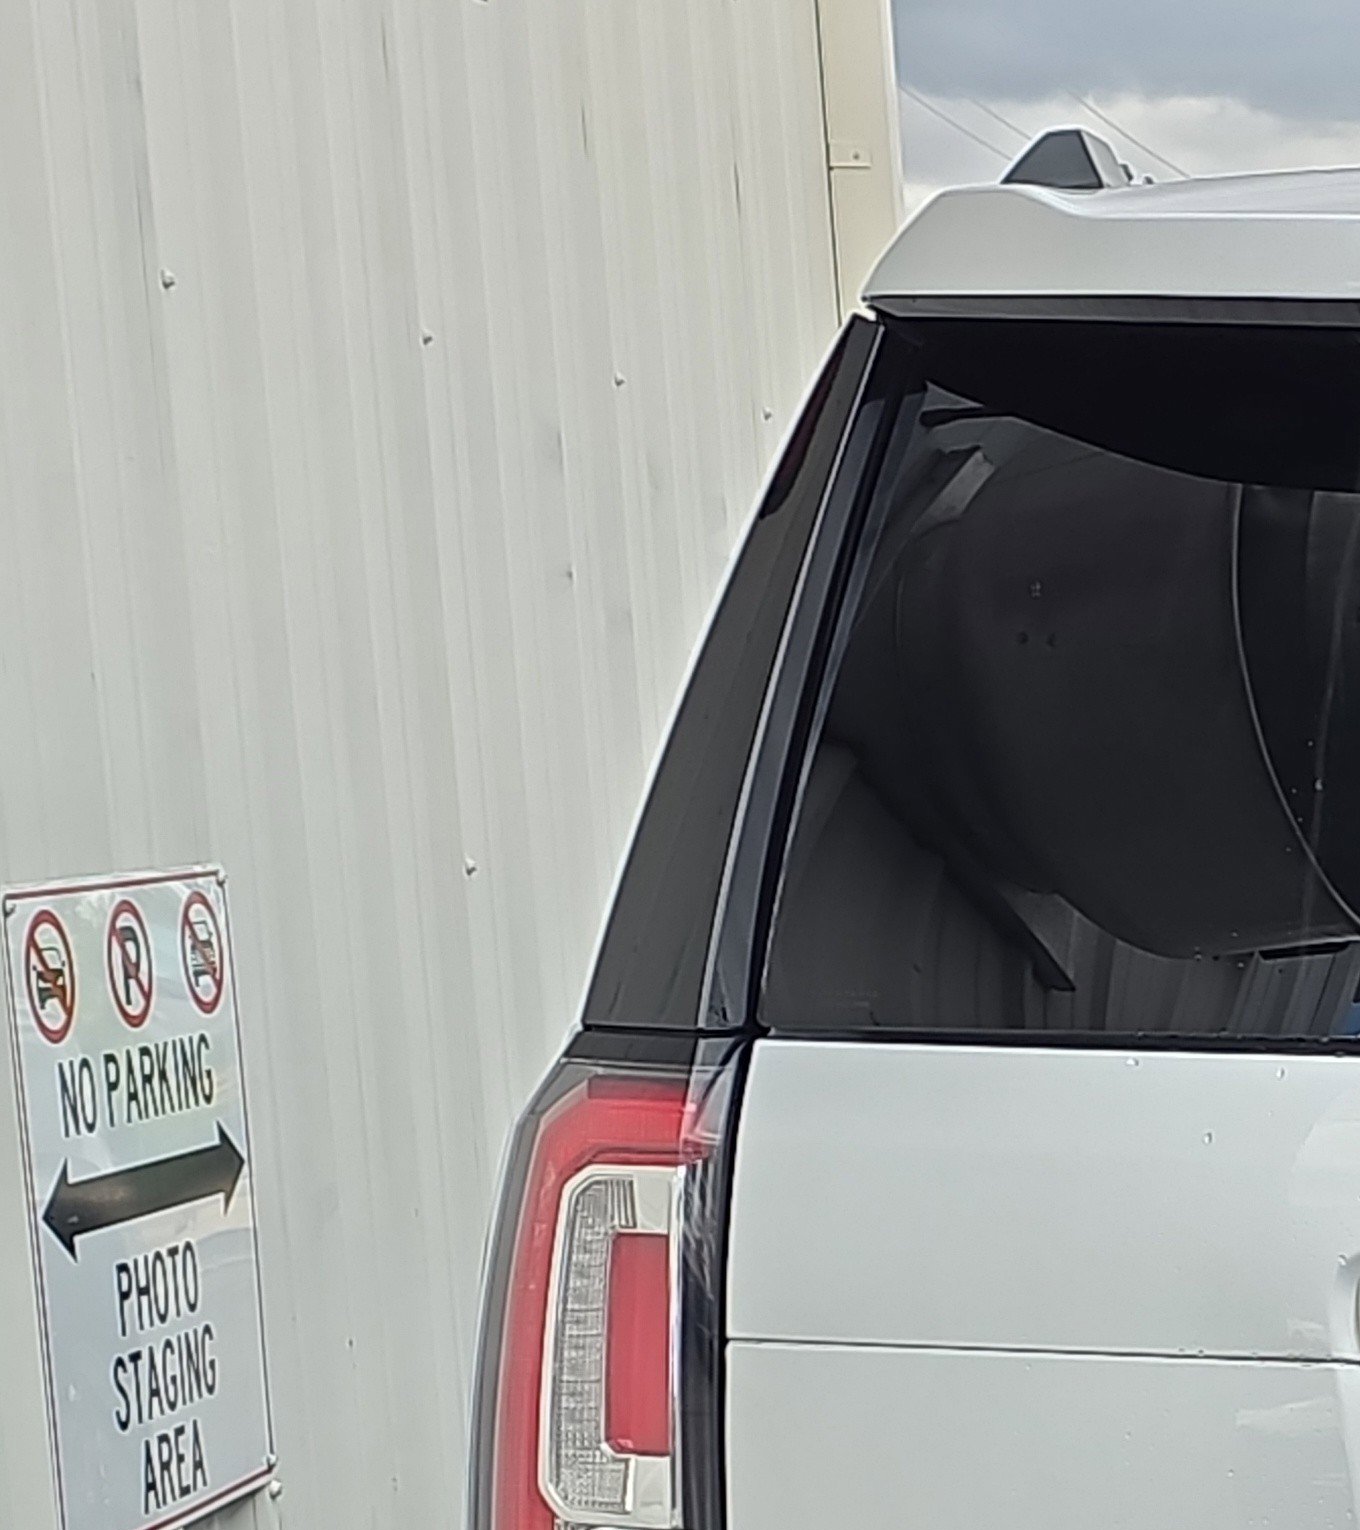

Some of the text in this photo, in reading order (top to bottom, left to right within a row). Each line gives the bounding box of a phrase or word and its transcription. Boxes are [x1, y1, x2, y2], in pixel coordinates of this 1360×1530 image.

[58, 1033, 214, 1138] NO PARKING
[115, 1240, 199, 1337] PHOTO
[113, 1323, 216, 1432] STAGING
[143, 1418, 207, 1515] AREA
